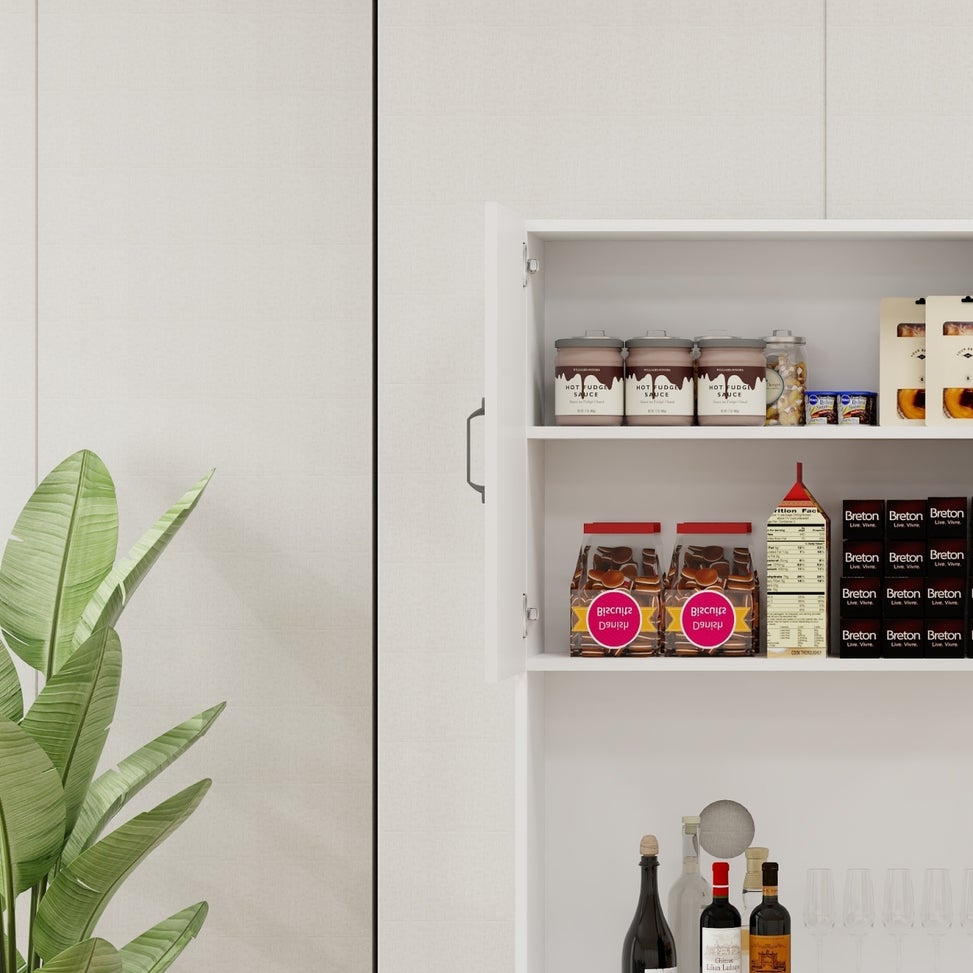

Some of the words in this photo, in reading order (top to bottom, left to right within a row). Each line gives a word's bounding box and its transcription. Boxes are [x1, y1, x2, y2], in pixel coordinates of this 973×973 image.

[845, 511, 879, 521] Breton
[889, 511, 923, 521] Breton
[930, 508, 964, 518] Breton
[845, 552, 879, 563] Breton
[889, 552, 923, 563] Breton
[930, 550, 964, 560] Breton
[842, 588, 876, 598] Breton
[887, 588, 920, 598] Breton
[928, 588, 961, 598] Breton
[842, 630, 876, 640] Breton
[887, 630, 920, 640] Breton
[928, 630, 961, 640] Breton
